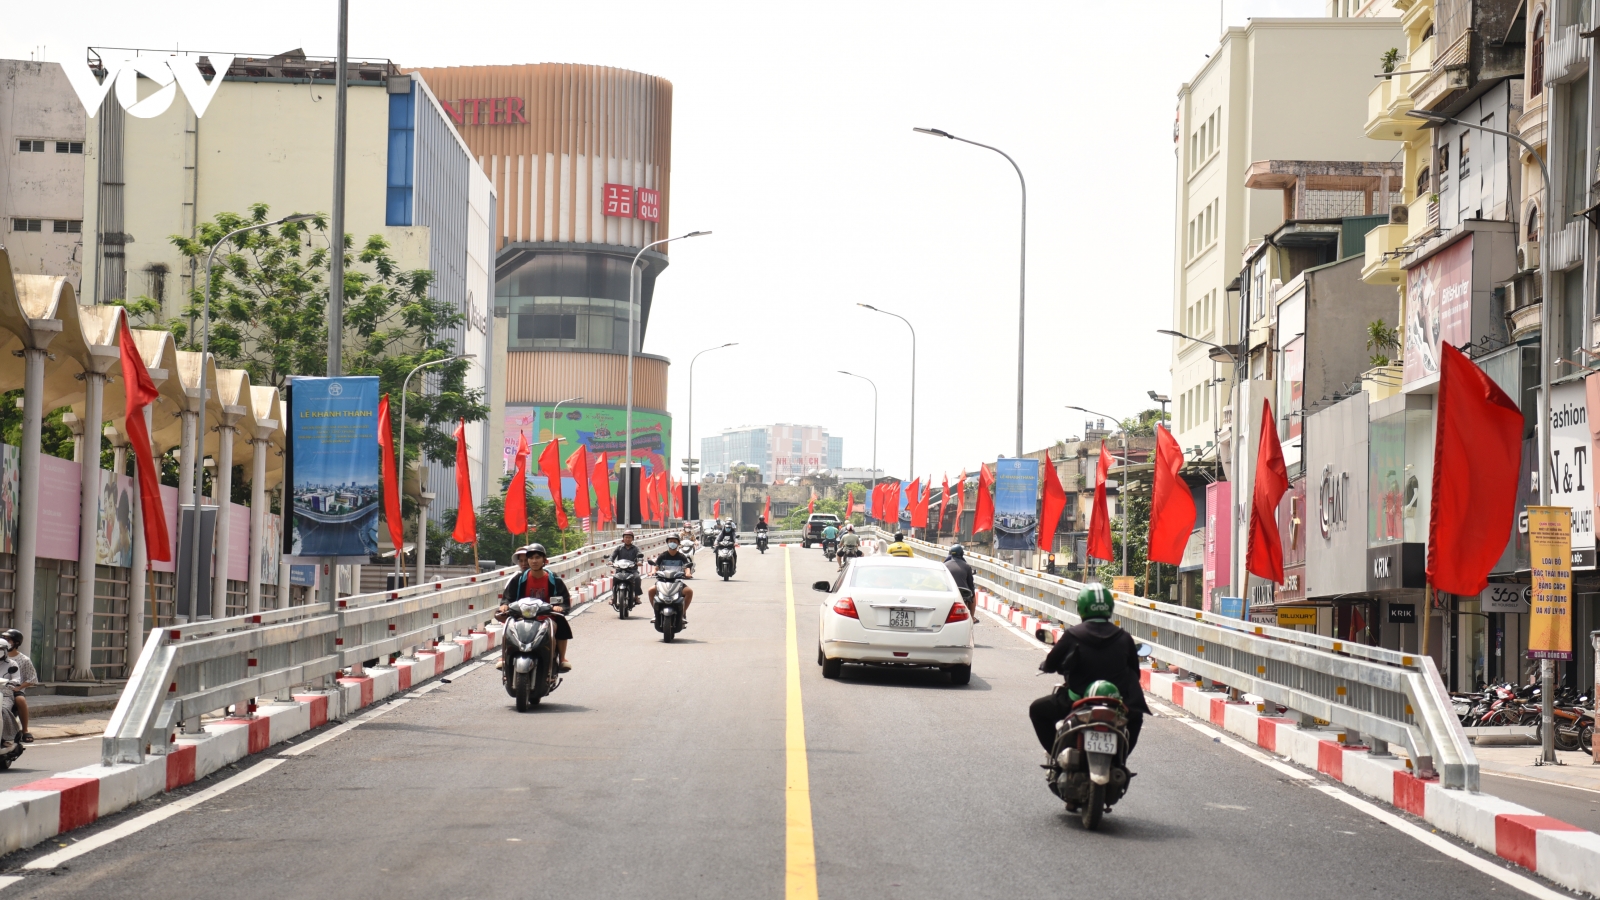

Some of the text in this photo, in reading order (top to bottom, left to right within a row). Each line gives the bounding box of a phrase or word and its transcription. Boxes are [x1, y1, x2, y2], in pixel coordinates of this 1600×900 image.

[642, 191, 657, 206] UNI
[641, 205, 658, 219] QLO
[1563, 462, 1573, 494] &
[1574, 446, 1587, 491] T
[1090, 603, 1110, 611] Grab
[895, 611, 909, 619] 29A
[1391, 609, 1412, 617] KRIK
